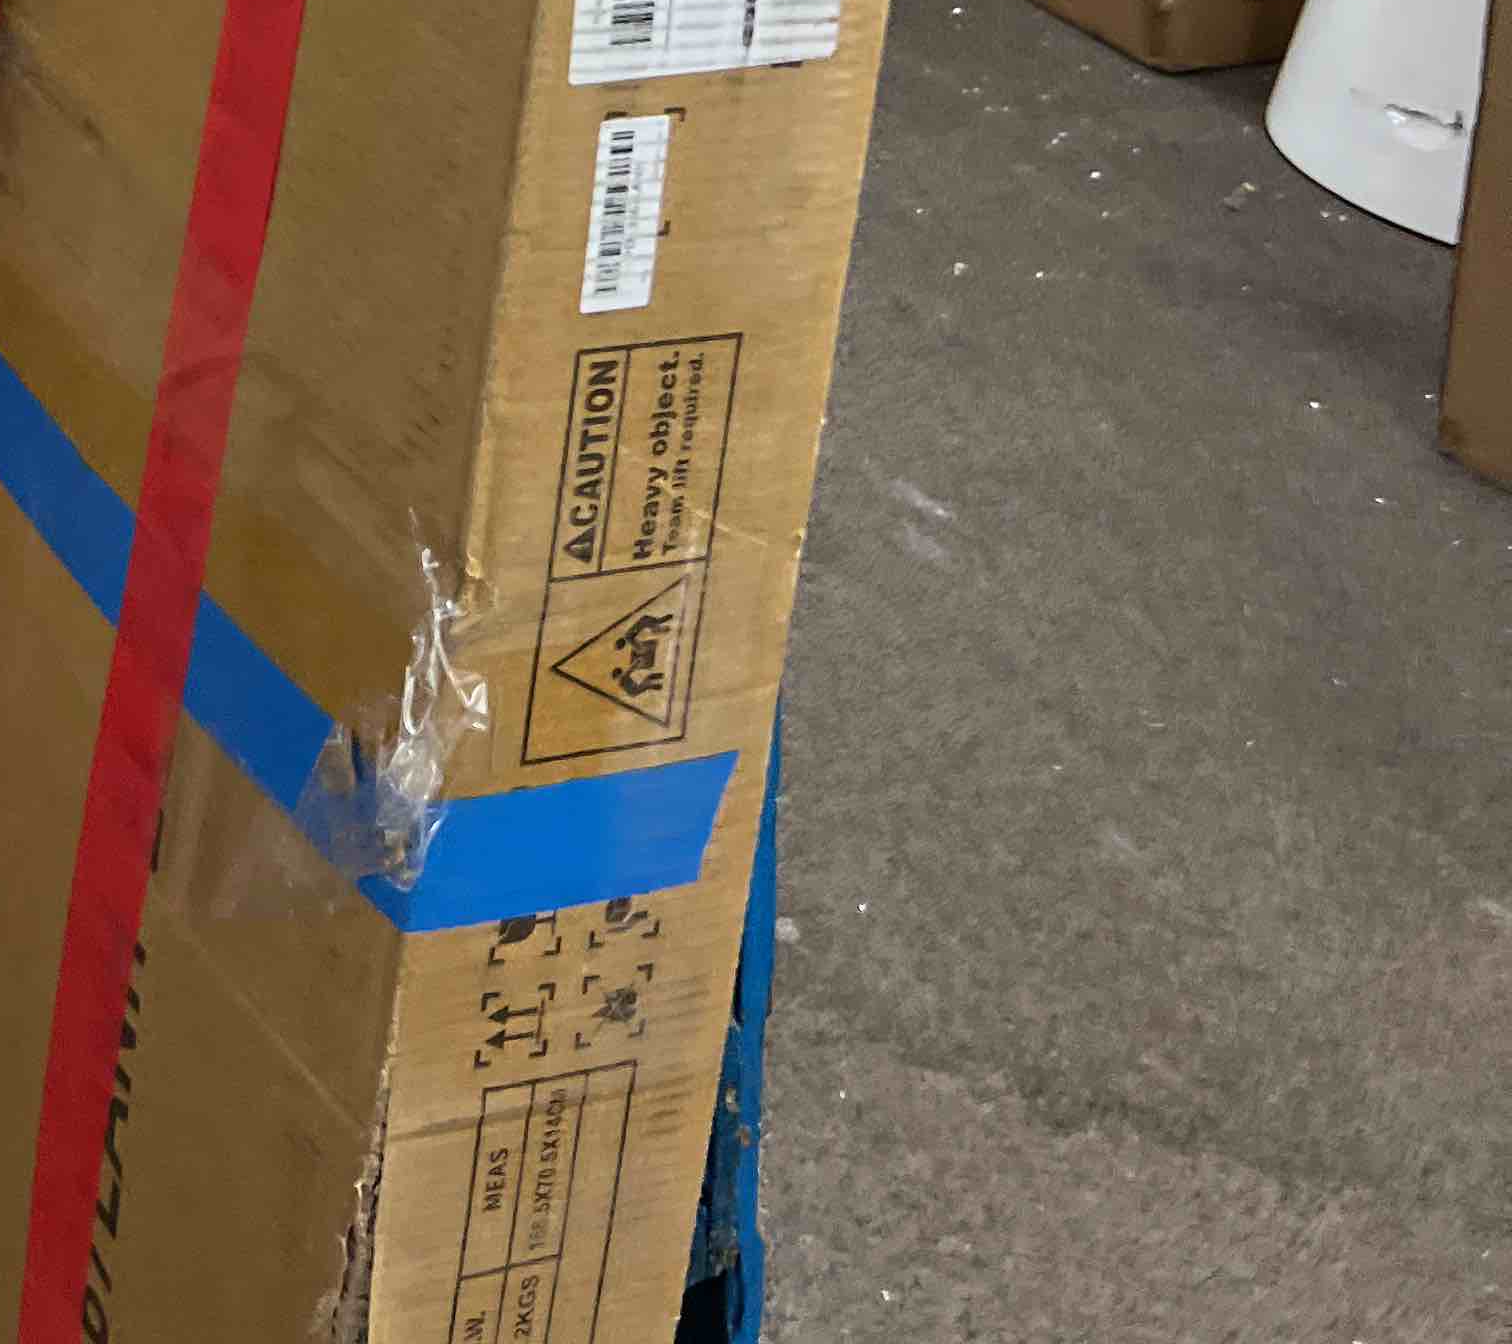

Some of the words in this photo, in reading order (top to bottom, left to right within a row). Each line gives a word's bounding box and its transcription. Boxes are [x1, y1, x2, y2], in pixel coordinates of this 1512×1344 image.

[571, 360, 618, 528] CAUTION
[632, 466, 663, 561] Heavy
[649, 351, 681, 455] object.
[483, 1148, 509, 1211] MEAS
